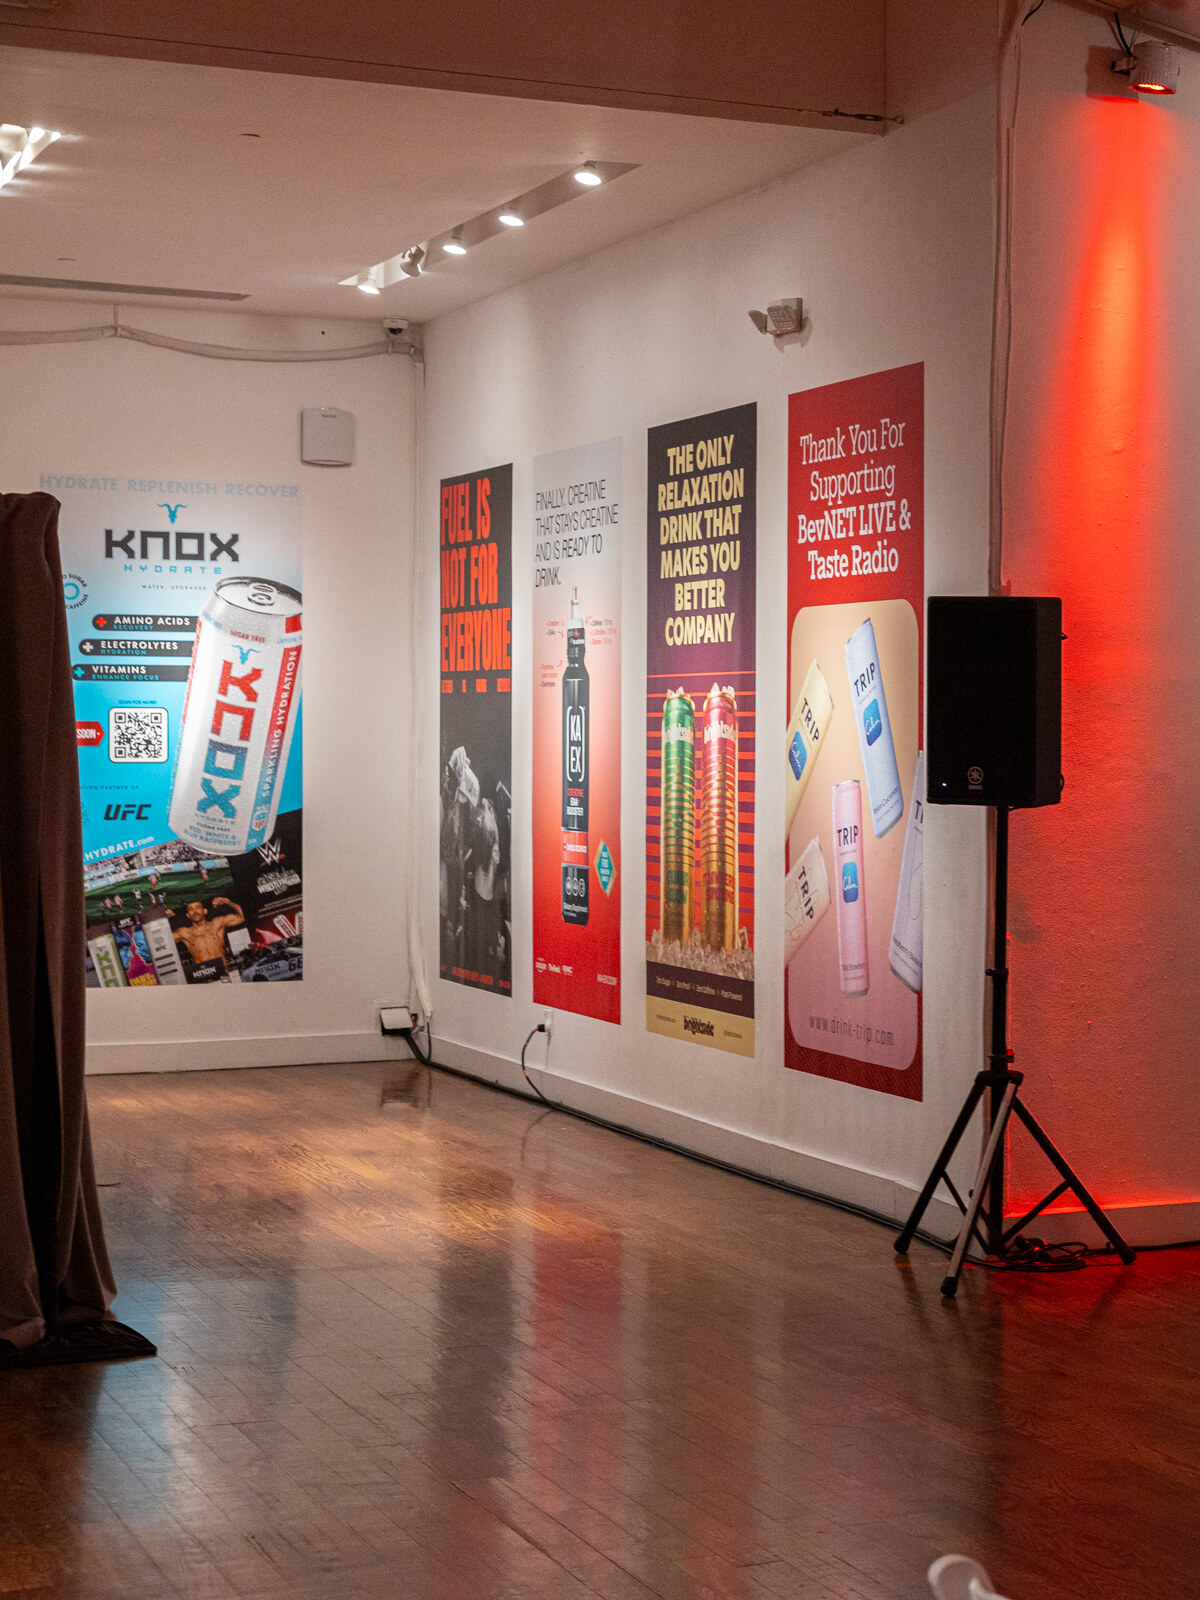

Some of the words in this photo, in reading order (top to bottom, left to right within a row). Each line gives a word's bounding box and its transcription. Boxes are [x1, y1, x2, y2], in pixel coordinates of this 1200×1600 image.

[667, 443, 694, 476] THE
[696, 434, 735, 471] ONLY
[800, 427, 846, 465] Thank
[848, 424, 877, 456] You
[880, 418, 906, 450] For
[39, 476, 119, 492] HYDRATE
[127, 479, 217, 496] REPLENISH
[225, 482, 299, 498] RECOVER
[535, 487, 566, 512] FINALLY,
[567, 479, 606, 506] CREATINE
[657, 468, 745, 512] RELAXATION
[810, 459, 896, 506] Supporting
[441, 482, 473, 546] FUEL
[477, 477, 492, 540] IS
[535, 516, 555, 537] THAT
[555, 511, 578, 534] STAYS
[580, 504, 619, 530] CREATINE
[660, 510, 703, 545] DRINK
[704, 504, 742, 538] THAT
[797, 506, 857, 544] BevNET
[859, 500, 896, 536] LIVE
[900, 498, 911, 531] &
[105, 528, 240, 563] KNOX
[535, 541, 551, 563] AND
[553, 540, 561, 560] IS
[561, 535, 590, 559] READY
[591, 533, 603, 555] TO
[660, 544, 708, 579] MAKES
[709, 540, 741, 573] YOU
[807, 549, 849, 580] Taste
[851, 538, 899, 576] Radio
[124, 564, 222, 575] HYDRATE
[441, 547, 467, 609] NOT
[470, 542, 499, 606] FOR
[535, 565, 561, 588] DRINK.
[674, 578, 726, 612] BETTER
[113, 616, 154, 625] AMINO
[157, 617, 190, 626] ACIDS
[664, 612, 736, 647] COMPANY
[100, 641, 178, 650] ELECTROLYTES
[441, 607, 512, 672] EVERYONE
[91, 665, 147, 674] VITAMINS
[853, 661, 877, 699] TRIP
[262, 729, 283, 798] SPARKLING
[275, 650, 299, 727] HYDRATION
[801, 697, 821, 743] TRIP
[104, 804, 152, 820] UFC
[83, 836, 155, 863] HYDRATE.com
[837, 825, 859, 848] TRIP
